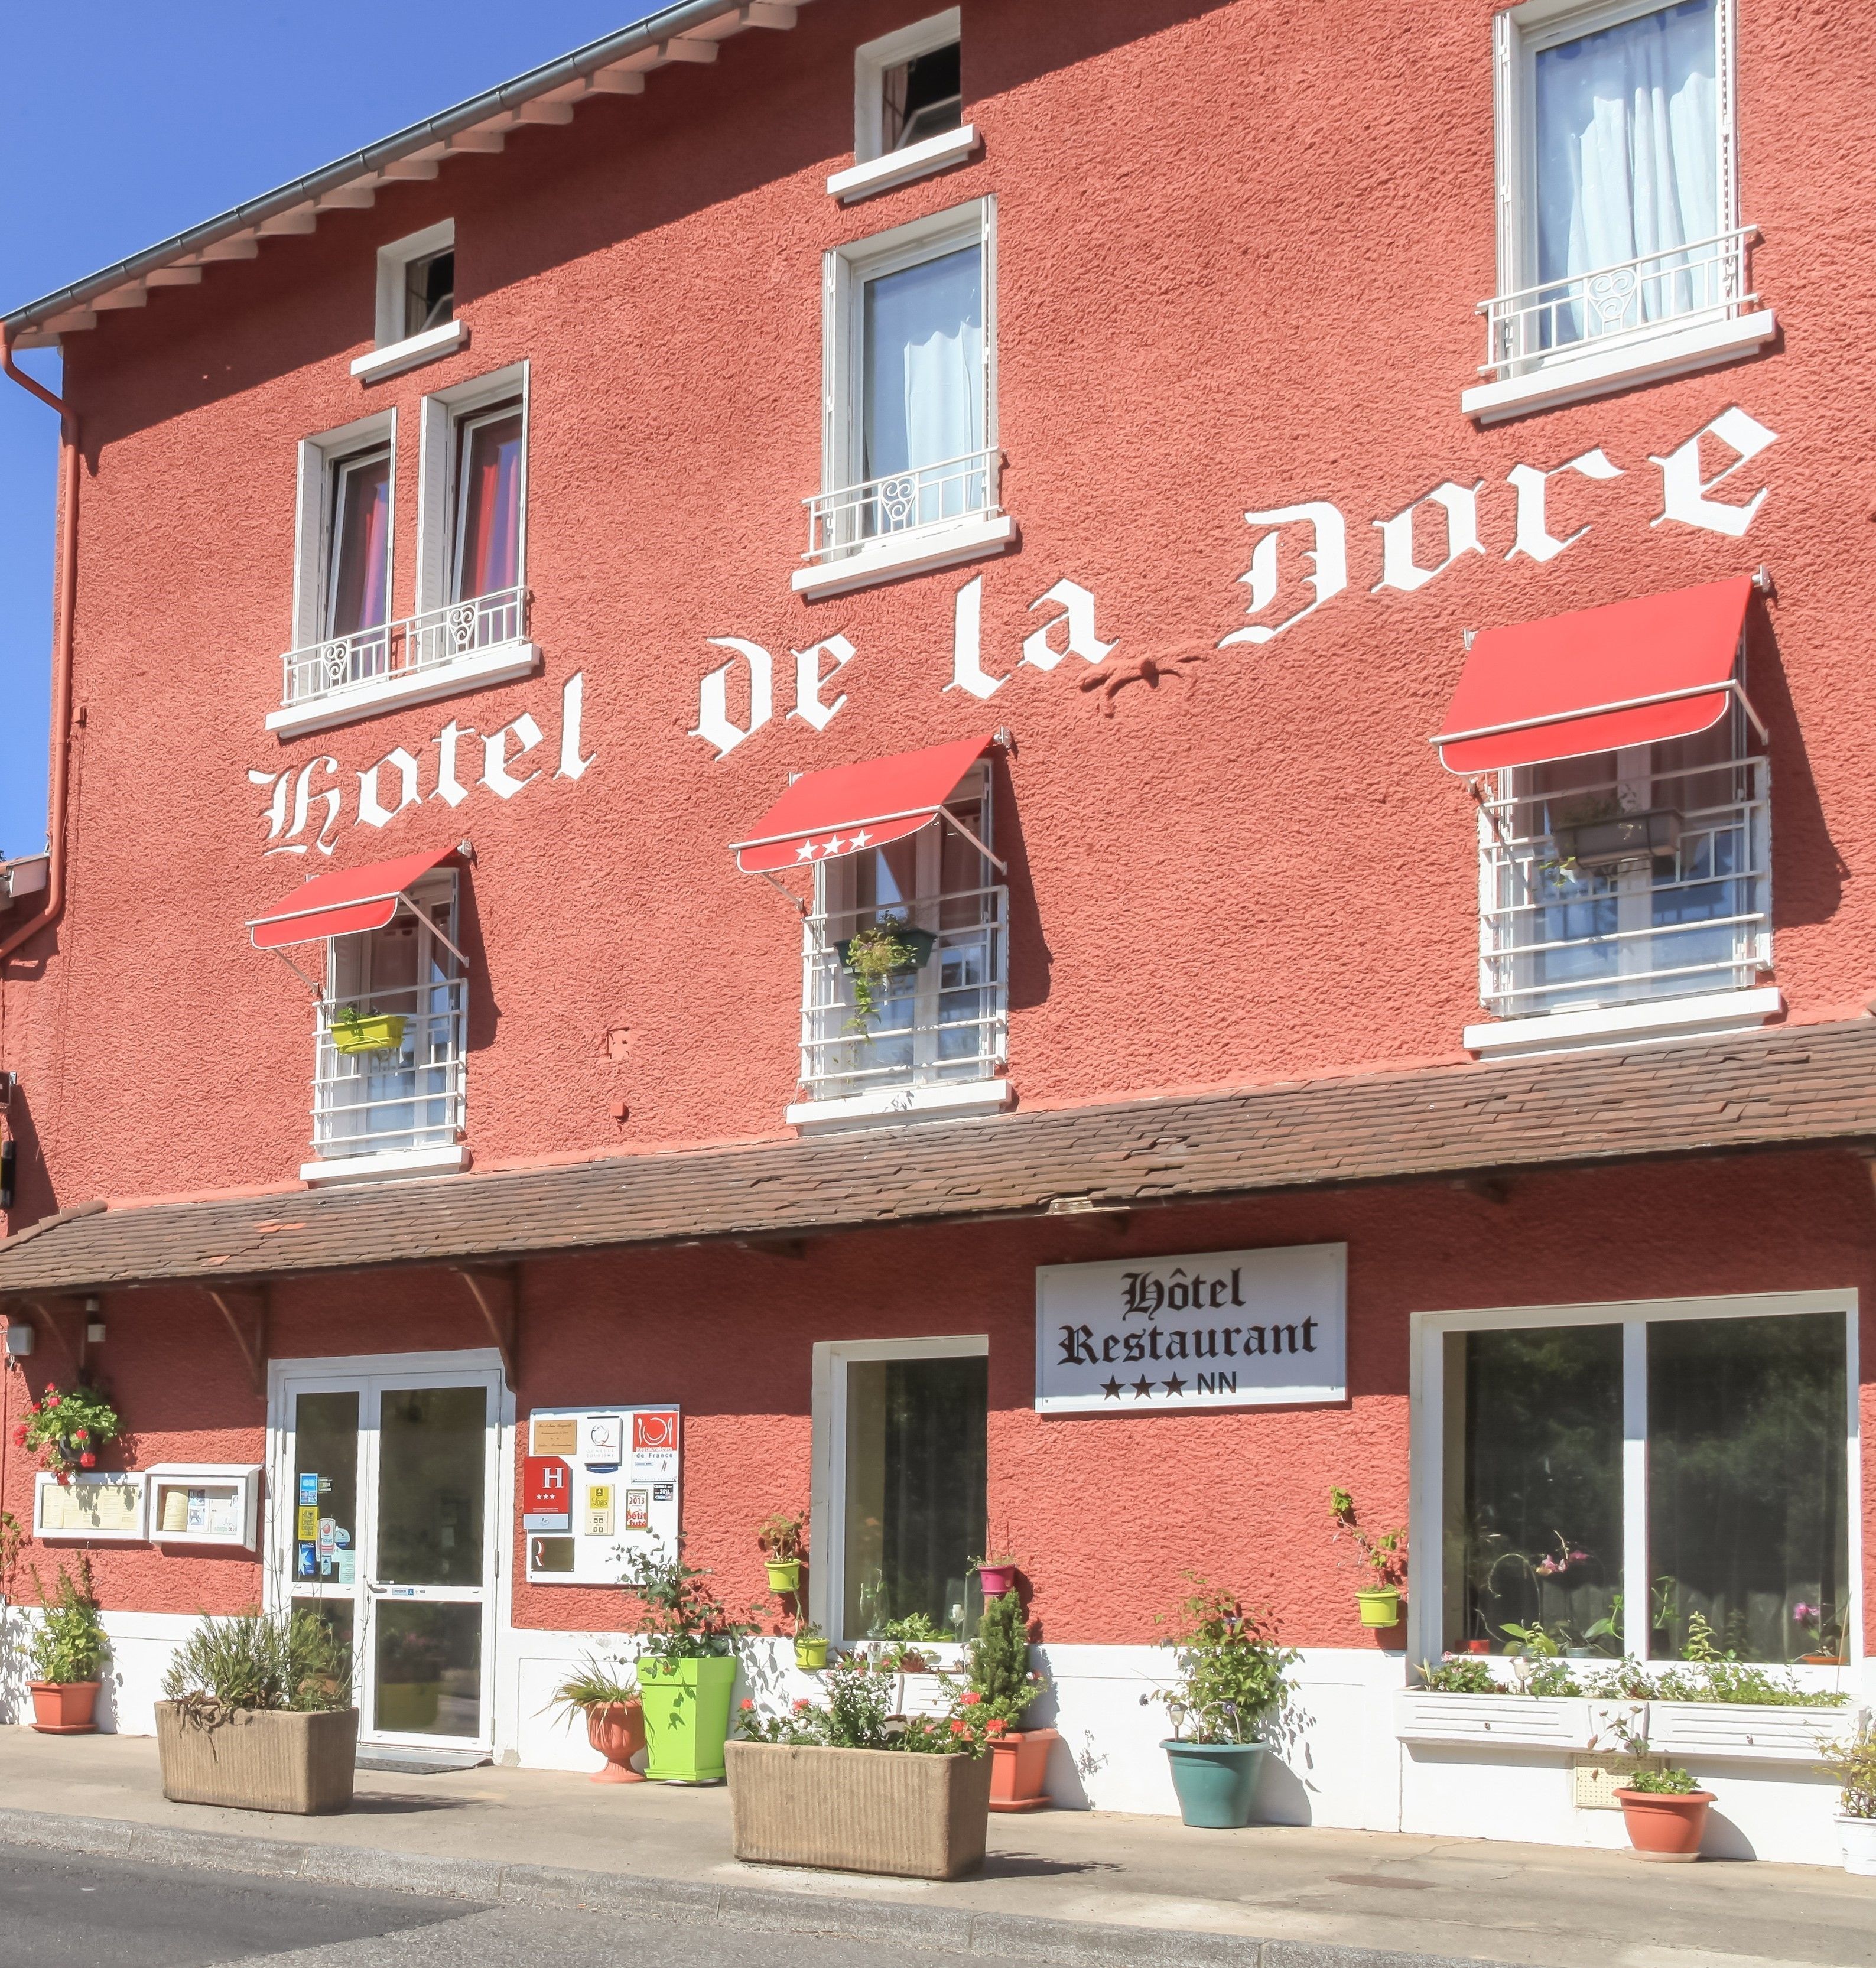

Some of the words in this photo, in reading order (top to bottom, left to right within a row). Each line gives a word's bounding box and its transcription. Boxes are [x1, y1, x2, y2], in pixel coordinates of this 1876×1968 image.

[248, 671, 597, 857] Hotel
[687, 633, 857, 762] de
[942, 575, 1119, 700] la
[1217, 406, 1779, 648] Dore
[1121, 1267, 1246, 1321] Hôtel
[1057, 1315, 1318, 1365] Restaurant
[1197, 1371, 1237, 1395] NN
[542, 1466, 564, 1489] H
[591, 1497, 607, 1507] Logis
